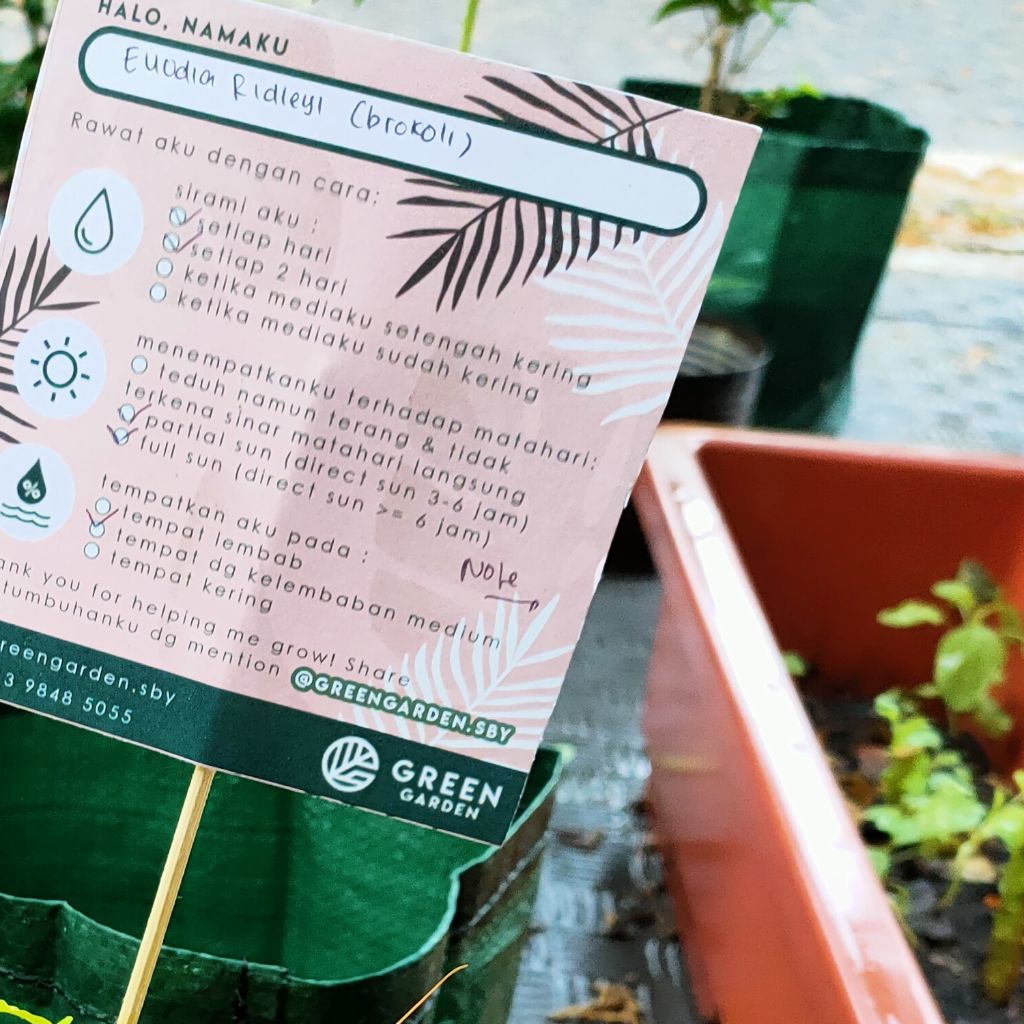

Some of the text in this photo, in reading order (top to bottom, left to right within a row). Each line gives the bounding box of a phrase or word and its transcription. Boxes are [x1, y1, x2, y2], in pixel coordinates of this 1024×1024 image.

[98, 0, 290, 56] HALO, NAMAKU
[71, 111, 381, 205] Rawat aku dengan cara:
[176, 182, 247, 213] sirami
[258, 205, 300, 228] aku
[190, 243, 348, 296] setiap 2 hari
[197, 218, 331, 264] setiap hari
[177, 290, 539, 404] ketika mediaku sudah kering
[184, 265, 591, 389] ketika mediaku setengah kering
[126, 380, 525, 507] terkena sinar matahari langsung
[137, 335, 598, 470] menempatkanku terhadap matahari:
[160, 363, 512, 474] teduh namun terang & tidak
[101, 474, 225, 523] tempatkan
[237, 517, 278, 538] aku
[287, 531, 351, 558] pada
[140, 435, 176, 458] full
[185, 452, 222, 471] sun
[235, 463, 316, 499] (direct
[327, 491, 365, 512] sun
[415, 513, 426, 528] 6
[435, 518, 491, 549] jam)
[145, 414, 529, 533] partial sun (direct sun 3-6 jam)
[112, 550, 273, 614] tempat kering
[123, 505, 303, 570] tempat lembab
[42, 571, 80, 592] you
[92, 583, 122, 604] for
[132, 596, 217, 634] helping
[227, 627, 260, 646] me
[271, 639, 336, 668] grow!
[345, 657, 411, 687] Share
[116, 527, 502, 649] tempat dg kelembaban medium
[26, 679, 73, 705] 9848
[82, 697, 132, 724] 5055
[150, 626, 178, 648] dg
[187, 640, 281, 677] mention
[295, 670, 513, 742] @GREENGARDEN.SBY
[391, 760, 504, 808] GREEN
[400, 787, 480, 820] GARDEN
